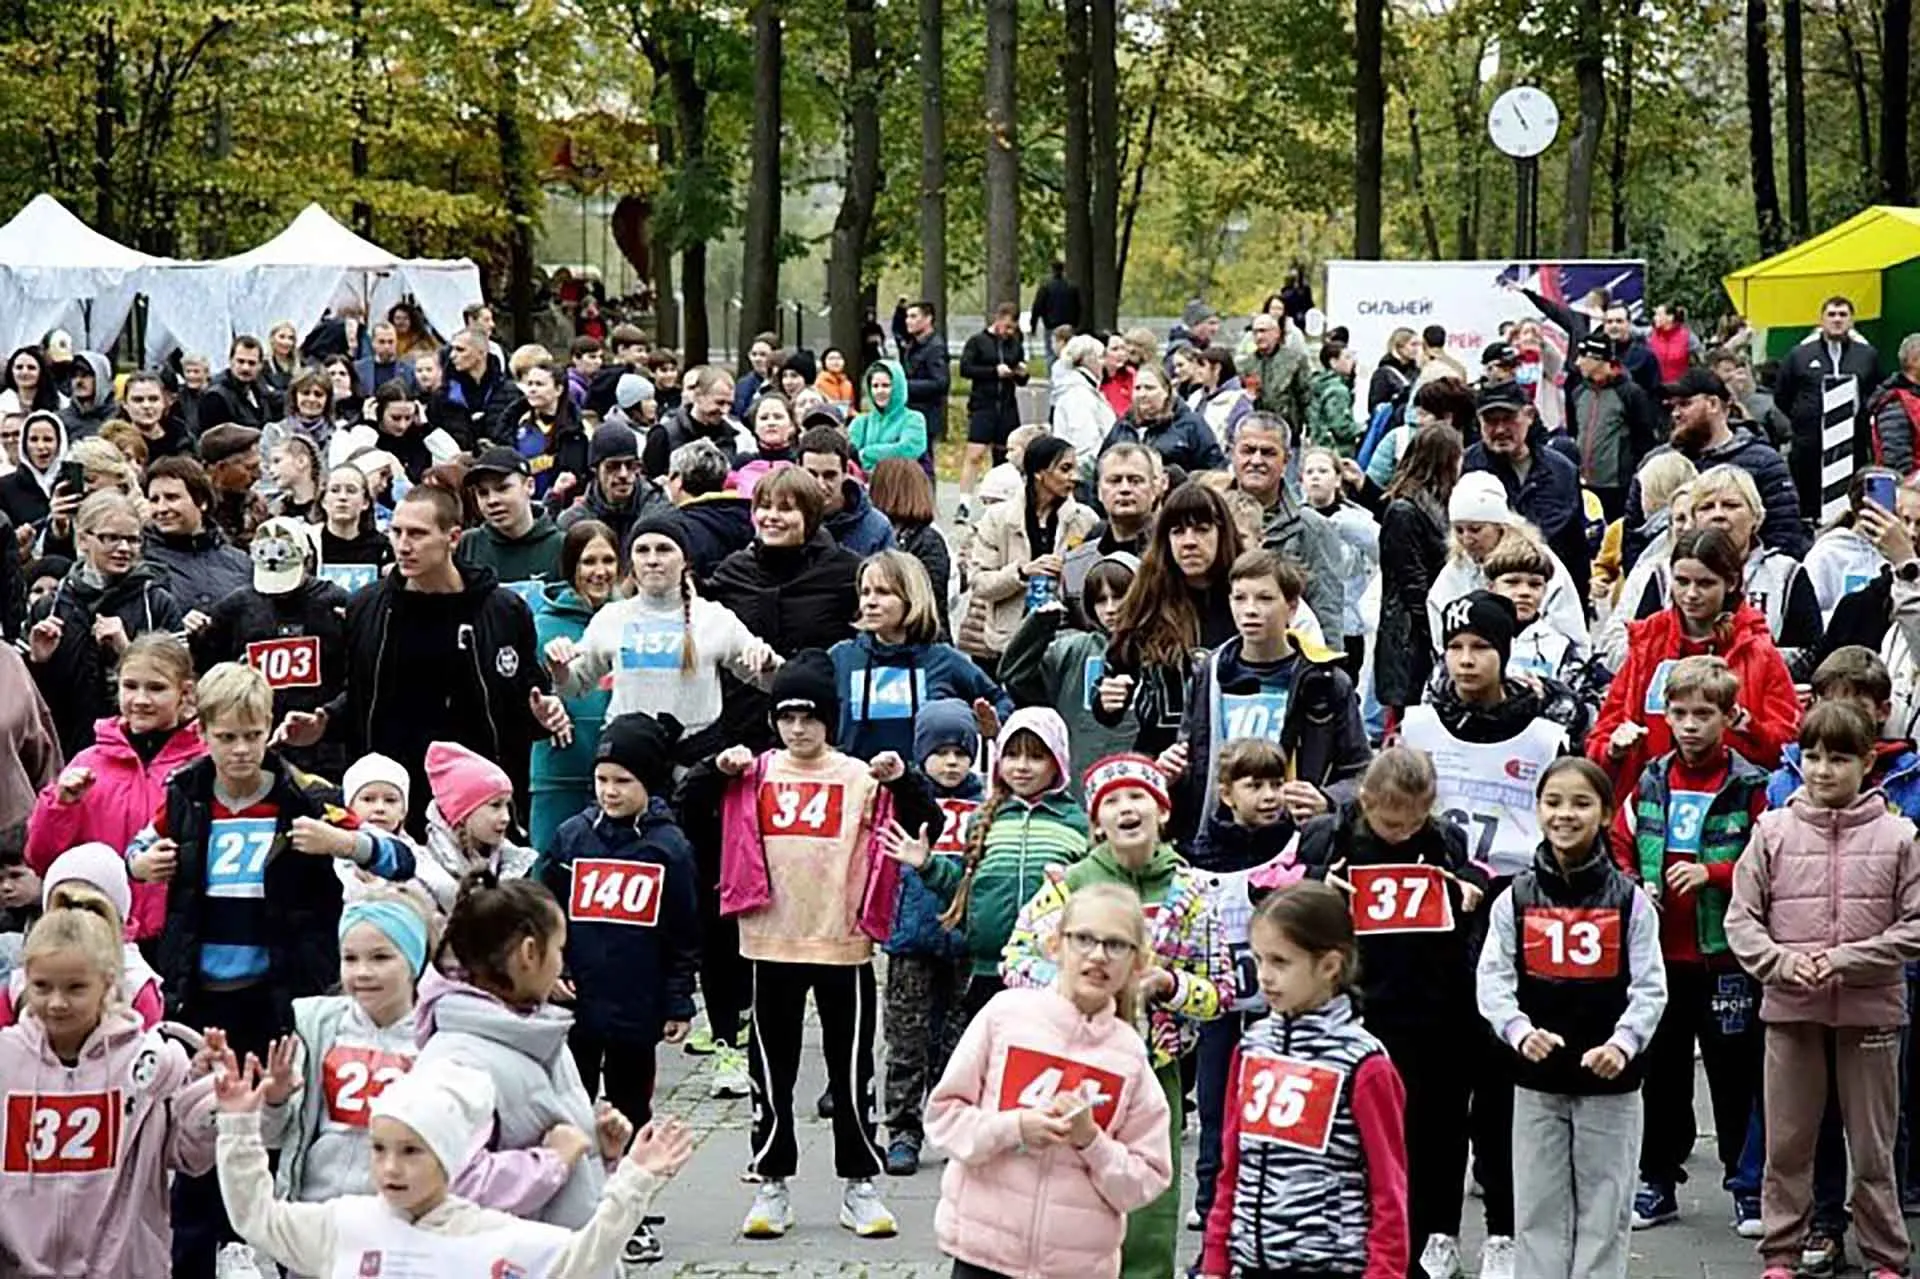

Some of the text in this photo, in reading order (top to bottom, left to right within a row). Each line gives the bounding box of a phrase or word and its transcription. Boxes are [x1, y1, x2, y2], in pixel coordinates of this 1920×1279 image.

[1357, 298, 1433, 315] СИЛЬНЕЙ!
[1449, 332, 1485, 349] РЕЙ!
[256, 646, 313, 680] 103
[771, 790, 829, 829] 34
[211, 831, 275, 876] 27
[579, 869, 655, 913] 140
[1367, 877, 1429, 921] 37
[1544, 920, 1603, 966] 13
[1243, 1069, 1314, 1129] 35
[25, 1106, 102, 1160] 32
